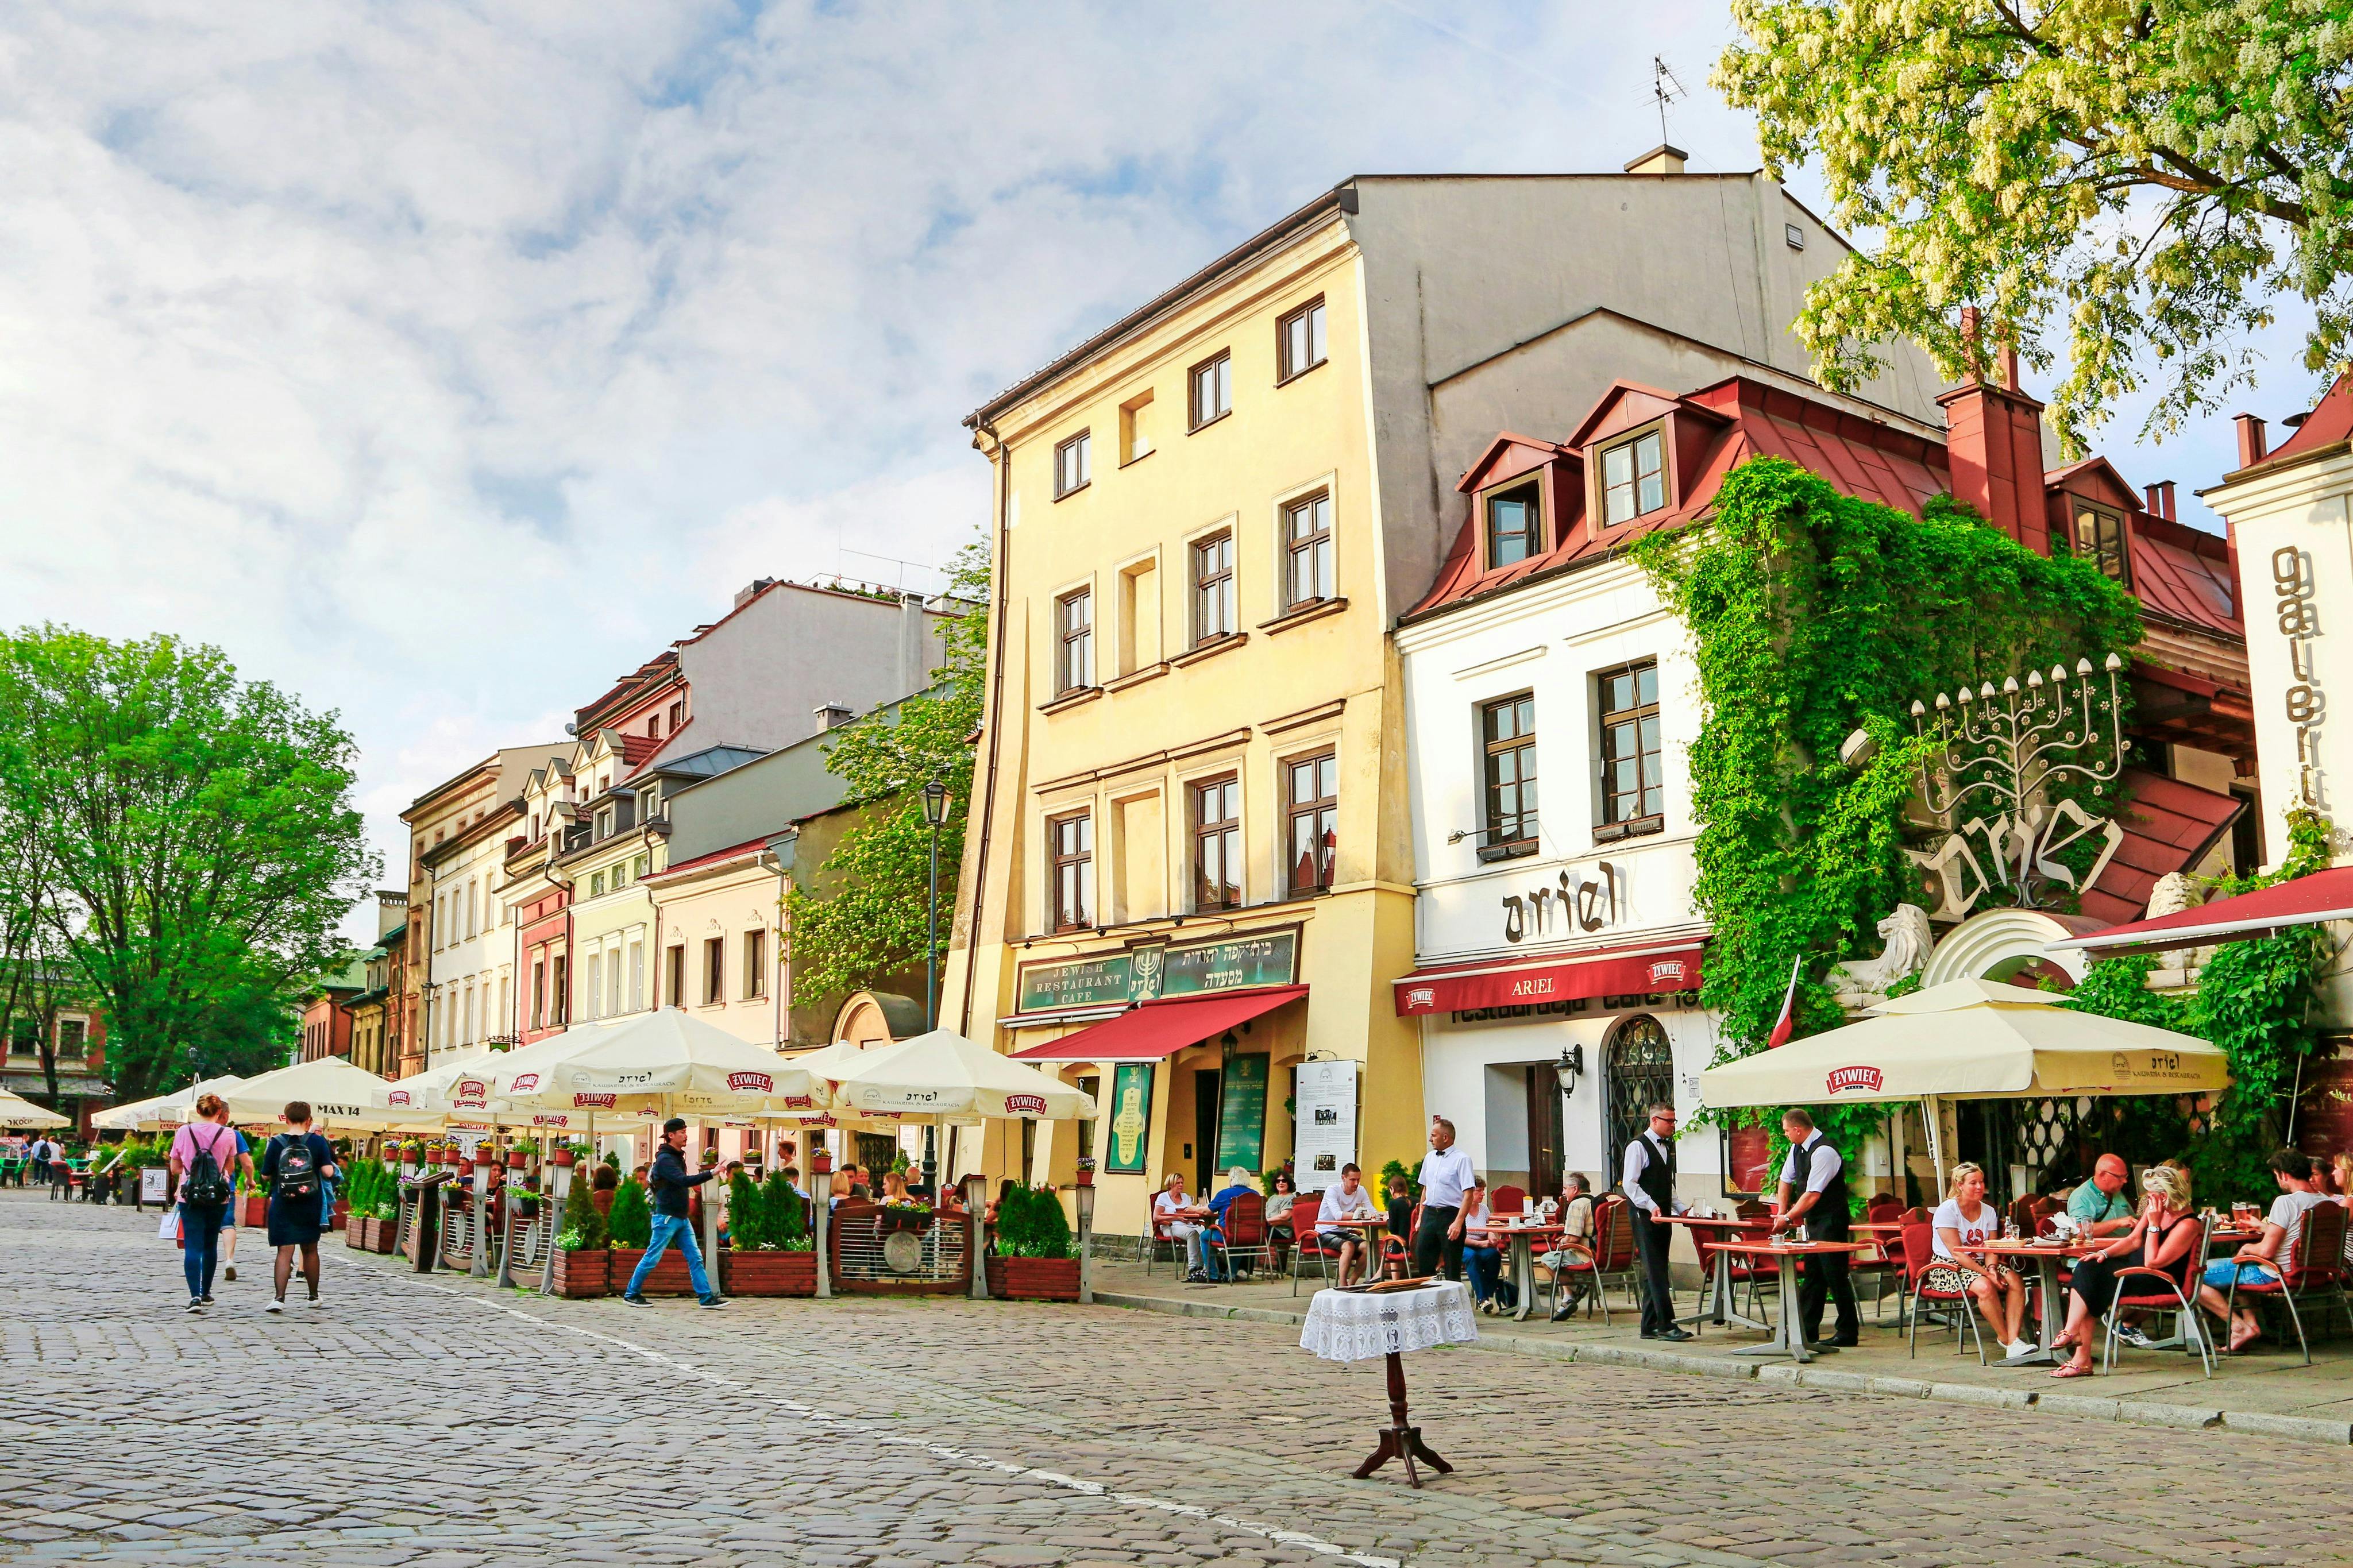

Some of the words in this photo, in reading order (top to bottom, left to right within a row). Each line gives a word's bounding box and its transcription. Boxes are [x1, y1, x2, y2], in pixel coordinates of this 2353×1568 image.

[1502, 860, 1615, 943] ariel
[1054, 963, 1104, 978] JEWISH
[1036, 975, 1121, 994] RESTAURANT
[1204, 969, 1243, 989] מסעדה
[1511, 978, 1555, 996] ARIEL
[1062, 991, 1091, 1004] CAFE
[2152, 1052, 2180, 1070] ariel
[517, 1076, 538, 1087] ŻYWIEC
[619, 1071, 652, 1083] ariel
[732, 1073, 768, 1087] ŻYWIEC
[1833, 1069, 1877, 1086] ŻYWIEC
[906, 1091, 938, 1102] ariel
[1010, 1096, 1042, 1109] ŻYWIEC
[318, 1105, 345, 1115] MAX
[348, 1106, 360, 1117] 14
